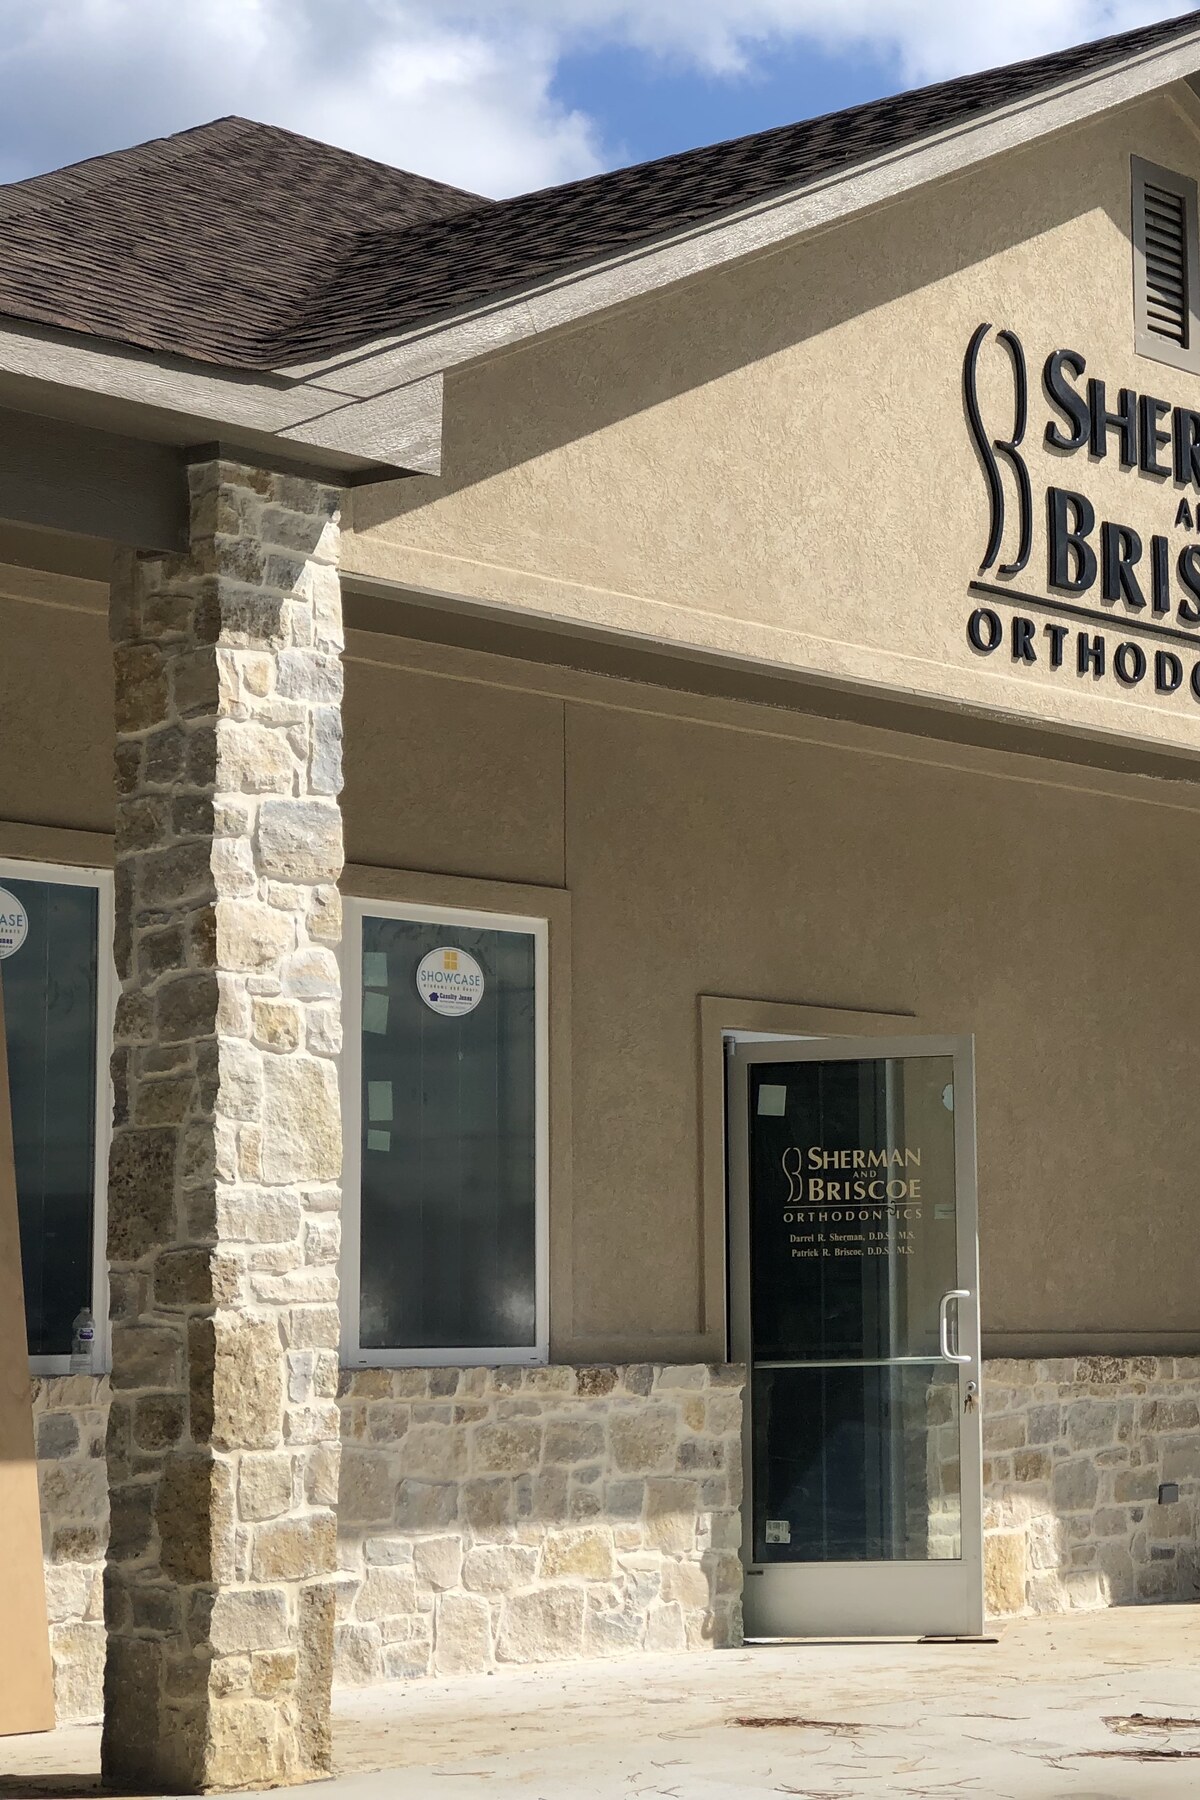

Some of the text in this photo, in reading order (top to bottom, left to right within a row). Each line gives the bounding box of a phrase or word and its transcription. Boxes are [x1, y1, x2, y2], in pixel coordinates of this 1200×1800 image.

[421, 970, 479, 986] SHOWCASE
[808, 1147, 920, 1170] SHERMAN
[852, 1170, 877, 1179] AND
[808, 1178, 921, 1201] BRISCOE
[789, 1233, 815, 1243] Darrel
[817, 1233, 826, 1242] R.
[898, 1230, 916, 1240] M.S.
[791, 1248, 819, 1258] Patrick
[822, 1248, 832, 1257] R.
[896, 1245, 915, 1255] M.S.
